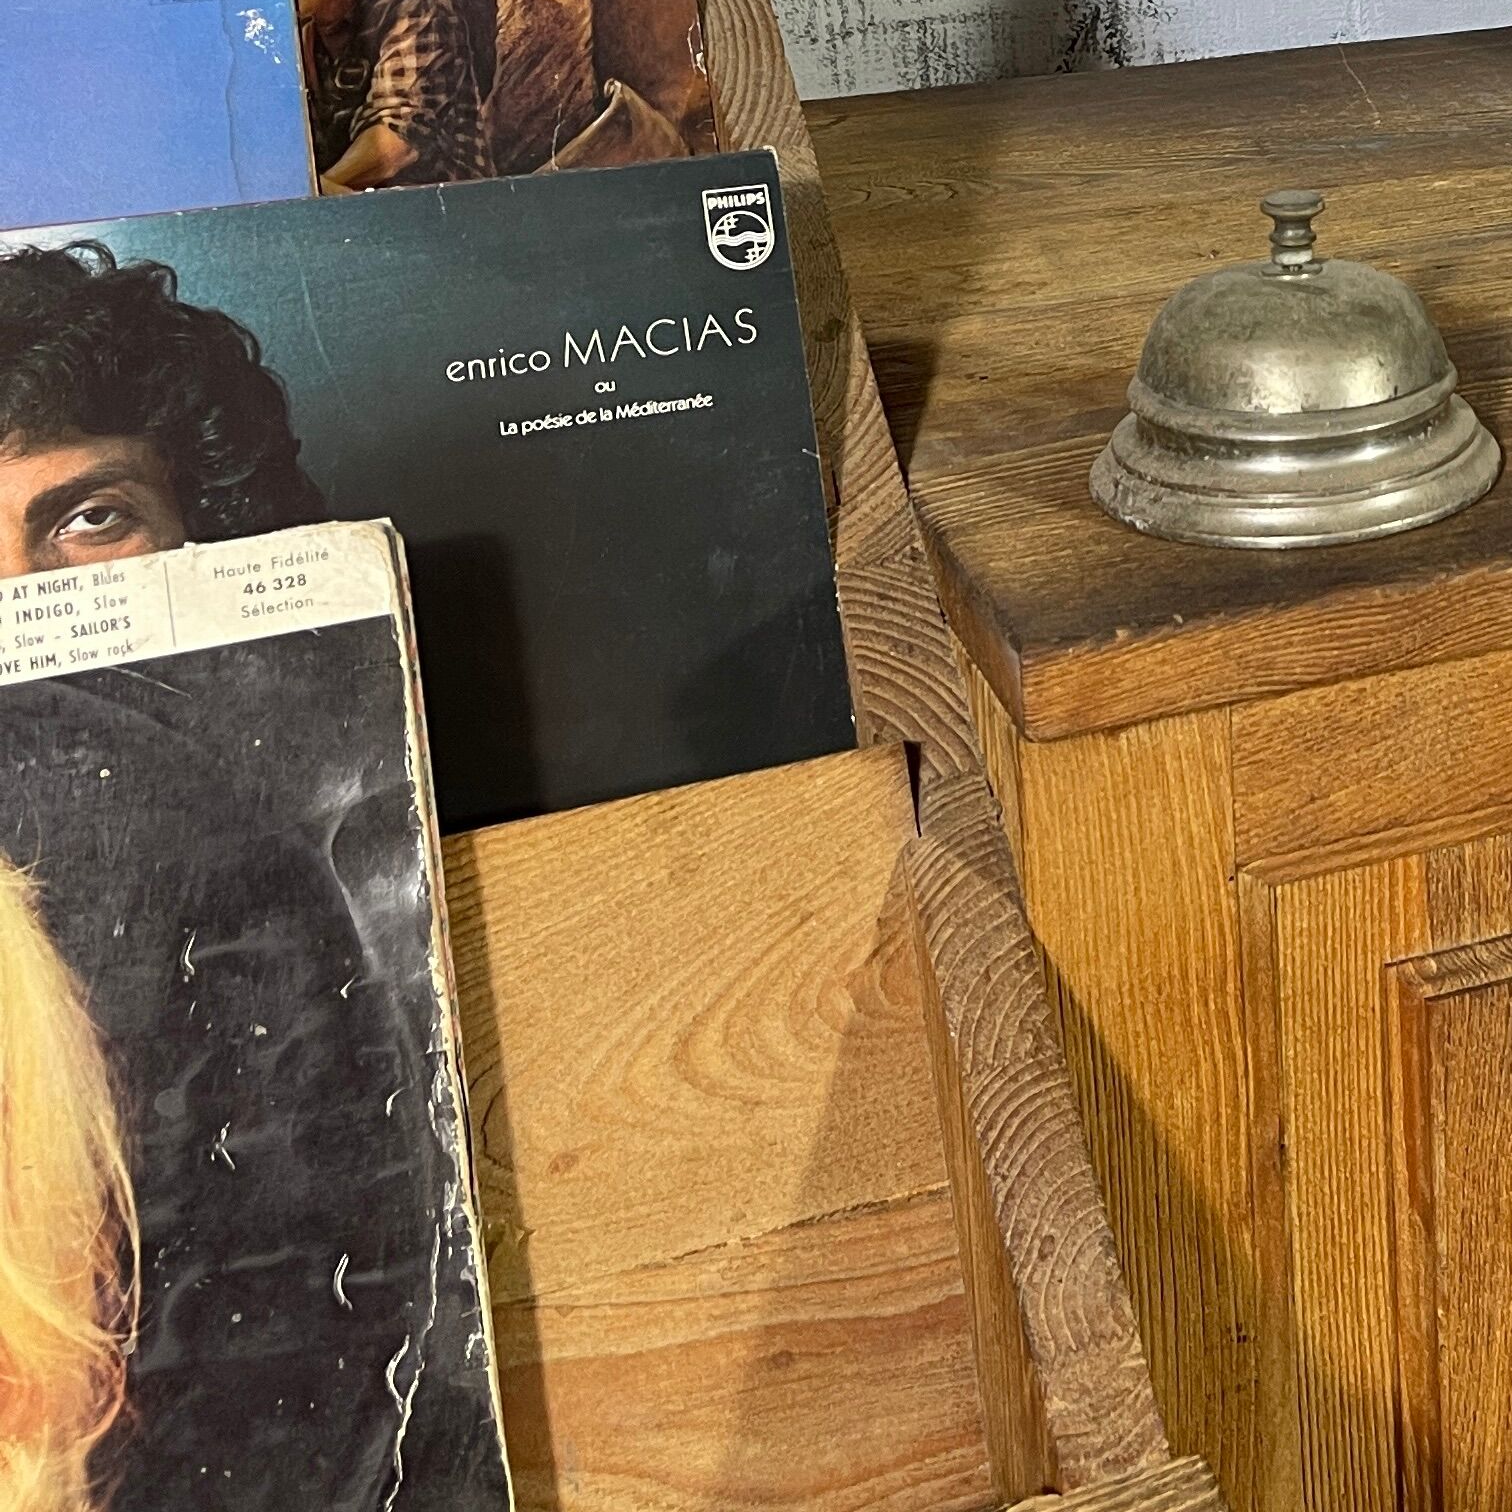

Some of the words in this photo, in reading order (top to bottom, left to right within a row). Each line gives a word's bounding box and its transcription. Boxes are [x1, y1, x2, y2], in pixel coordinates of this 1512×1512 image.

[707, 191, 766, 210] PHILIPS
[445, 348, 551, 383] enrico
[563, 307, 758, 368] MACIAS
[594, 379, 616, 394] ou
[499, 420, 518, 436] La
[521, 413, 574, 436] poésie
[575, 408, 597, 426] de
[599, 407, 613, 422] la
[615, 393, 714, 419] Méditerranée
[213, 562, 262, 579] Haute
[270, 547, 330, 570] Fidélité
[12, 584, 29, 601] AT
[37, 575, 84, 597] NIGHT,
[92, 571, 126, 587] Blues
[243, 581, 267, 595] 46
[272, 573, 307, 591] 328
[15, 601, 80, 625] INDIGO,
[93, 595, 129, 610] Slow
[241, 597, 315, 619] Sélection
[14, 633, 45, 649] Slow
[70, 615, 132, 639] SAILOR'S
[30, 652, 63, 671] HIM,
[69, 648, 99, 664] Slow
[107, 639, 134, 657] rock
